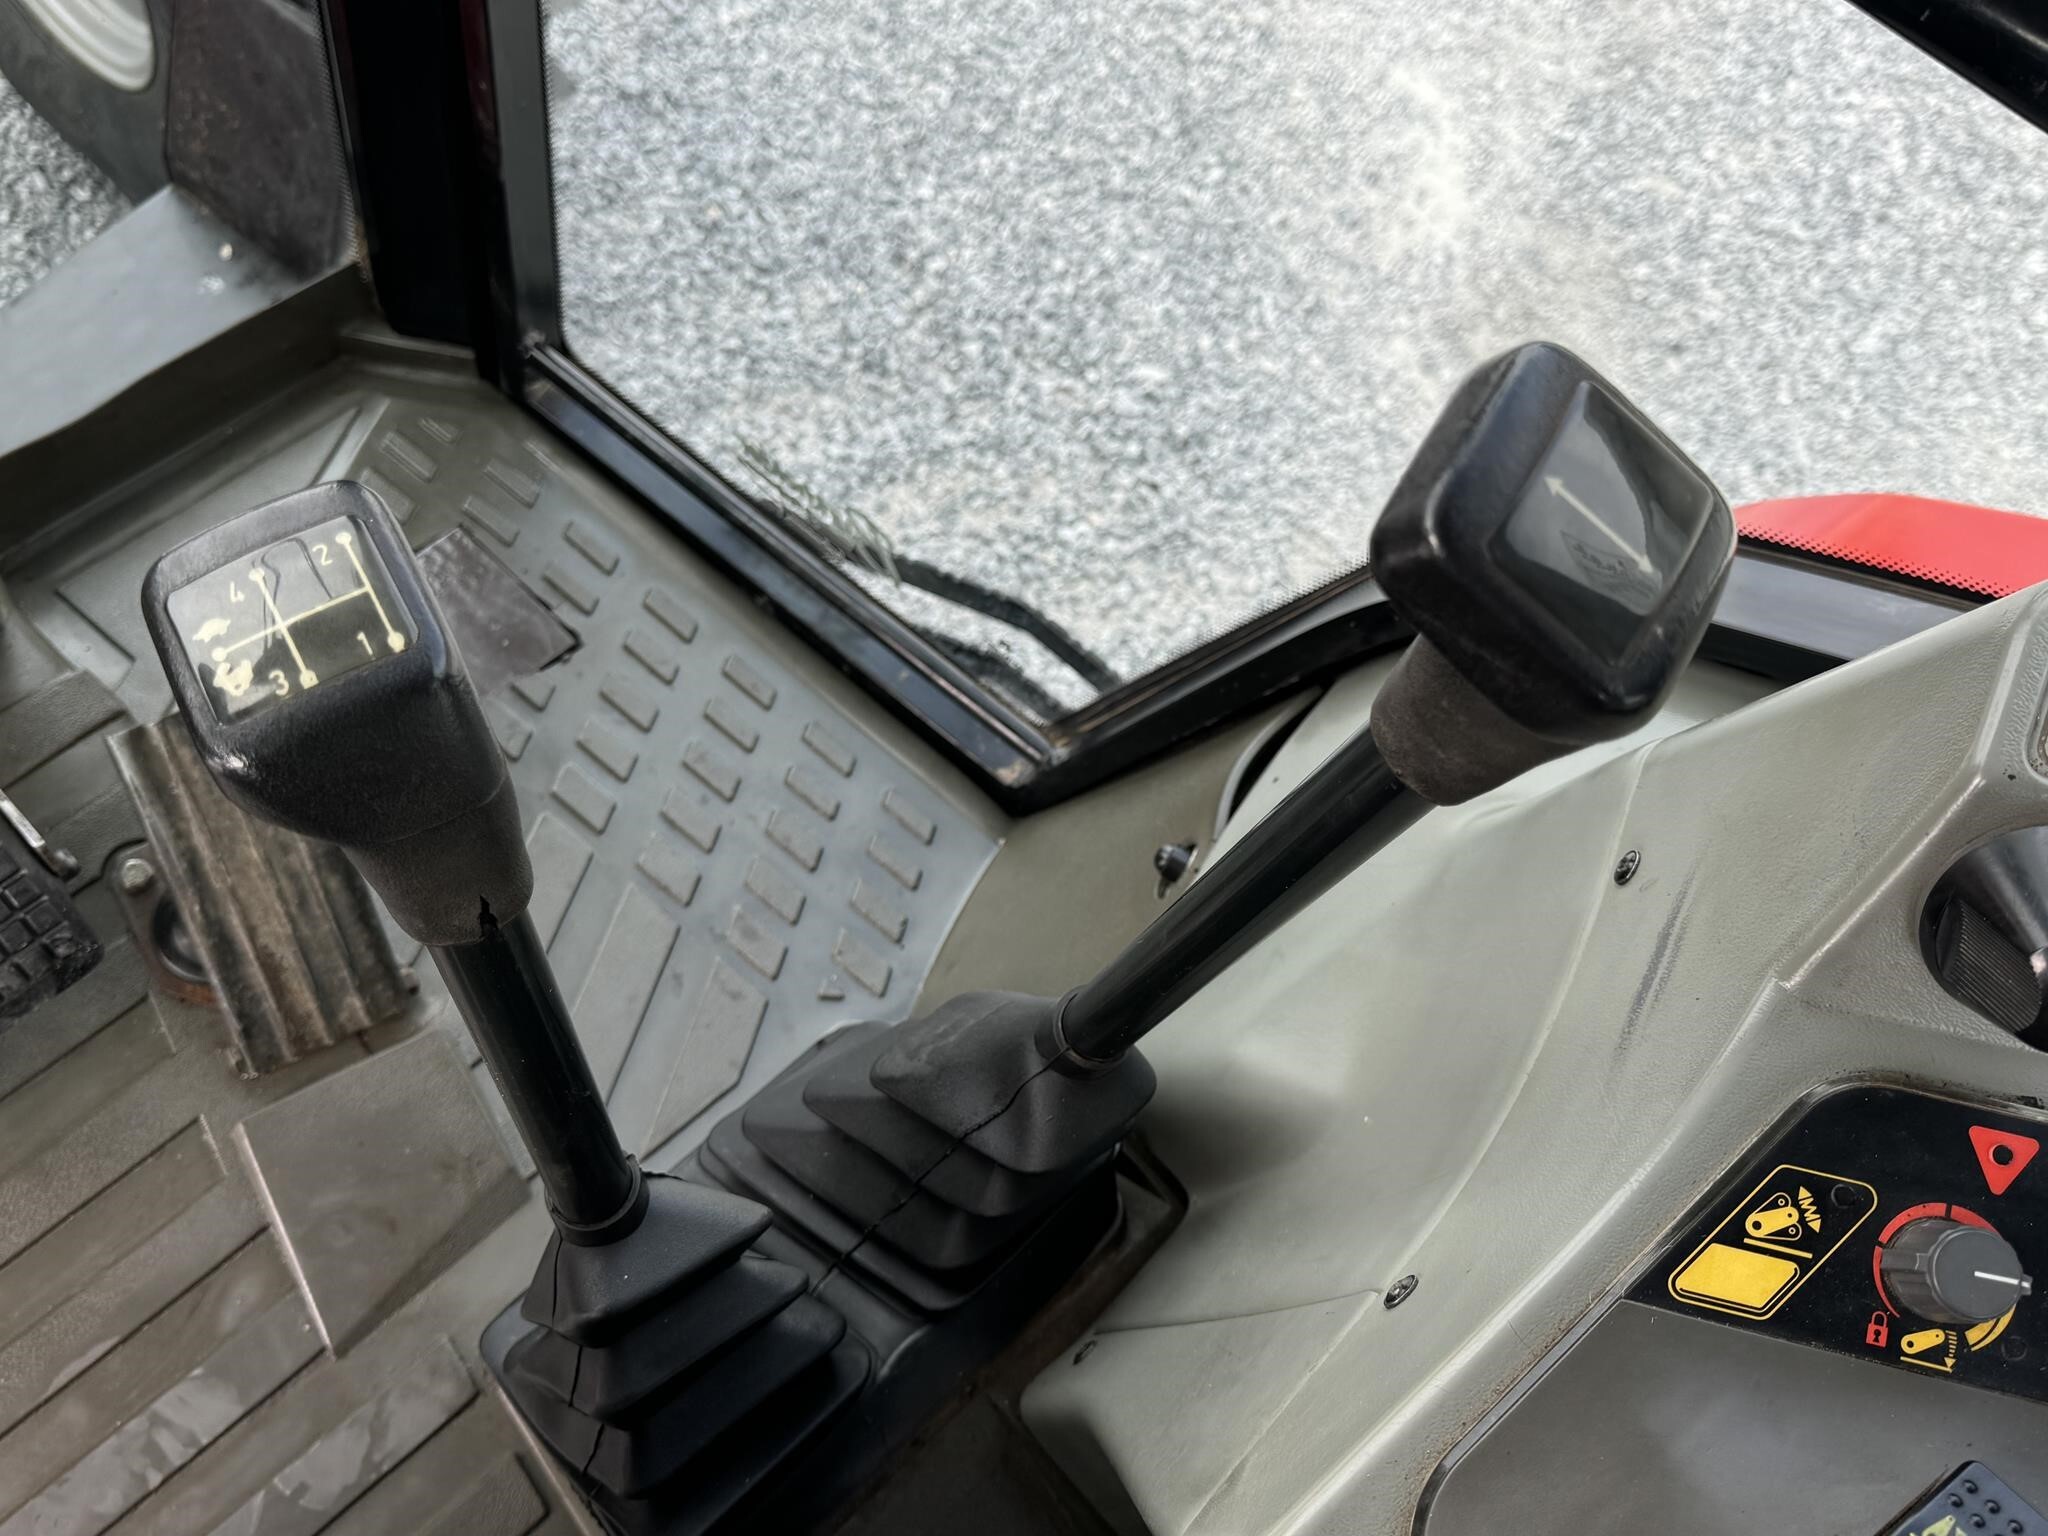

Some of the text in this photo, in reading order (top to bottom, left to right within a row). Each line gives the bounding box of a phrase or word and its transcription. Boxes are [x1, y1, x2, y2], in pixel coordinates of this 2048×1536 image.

[312, 544, 333, 566] 2
[230, 581, 245, 603] 4
[356, 631, 376, 660] 1
[269, 670, 290, 696] 3
